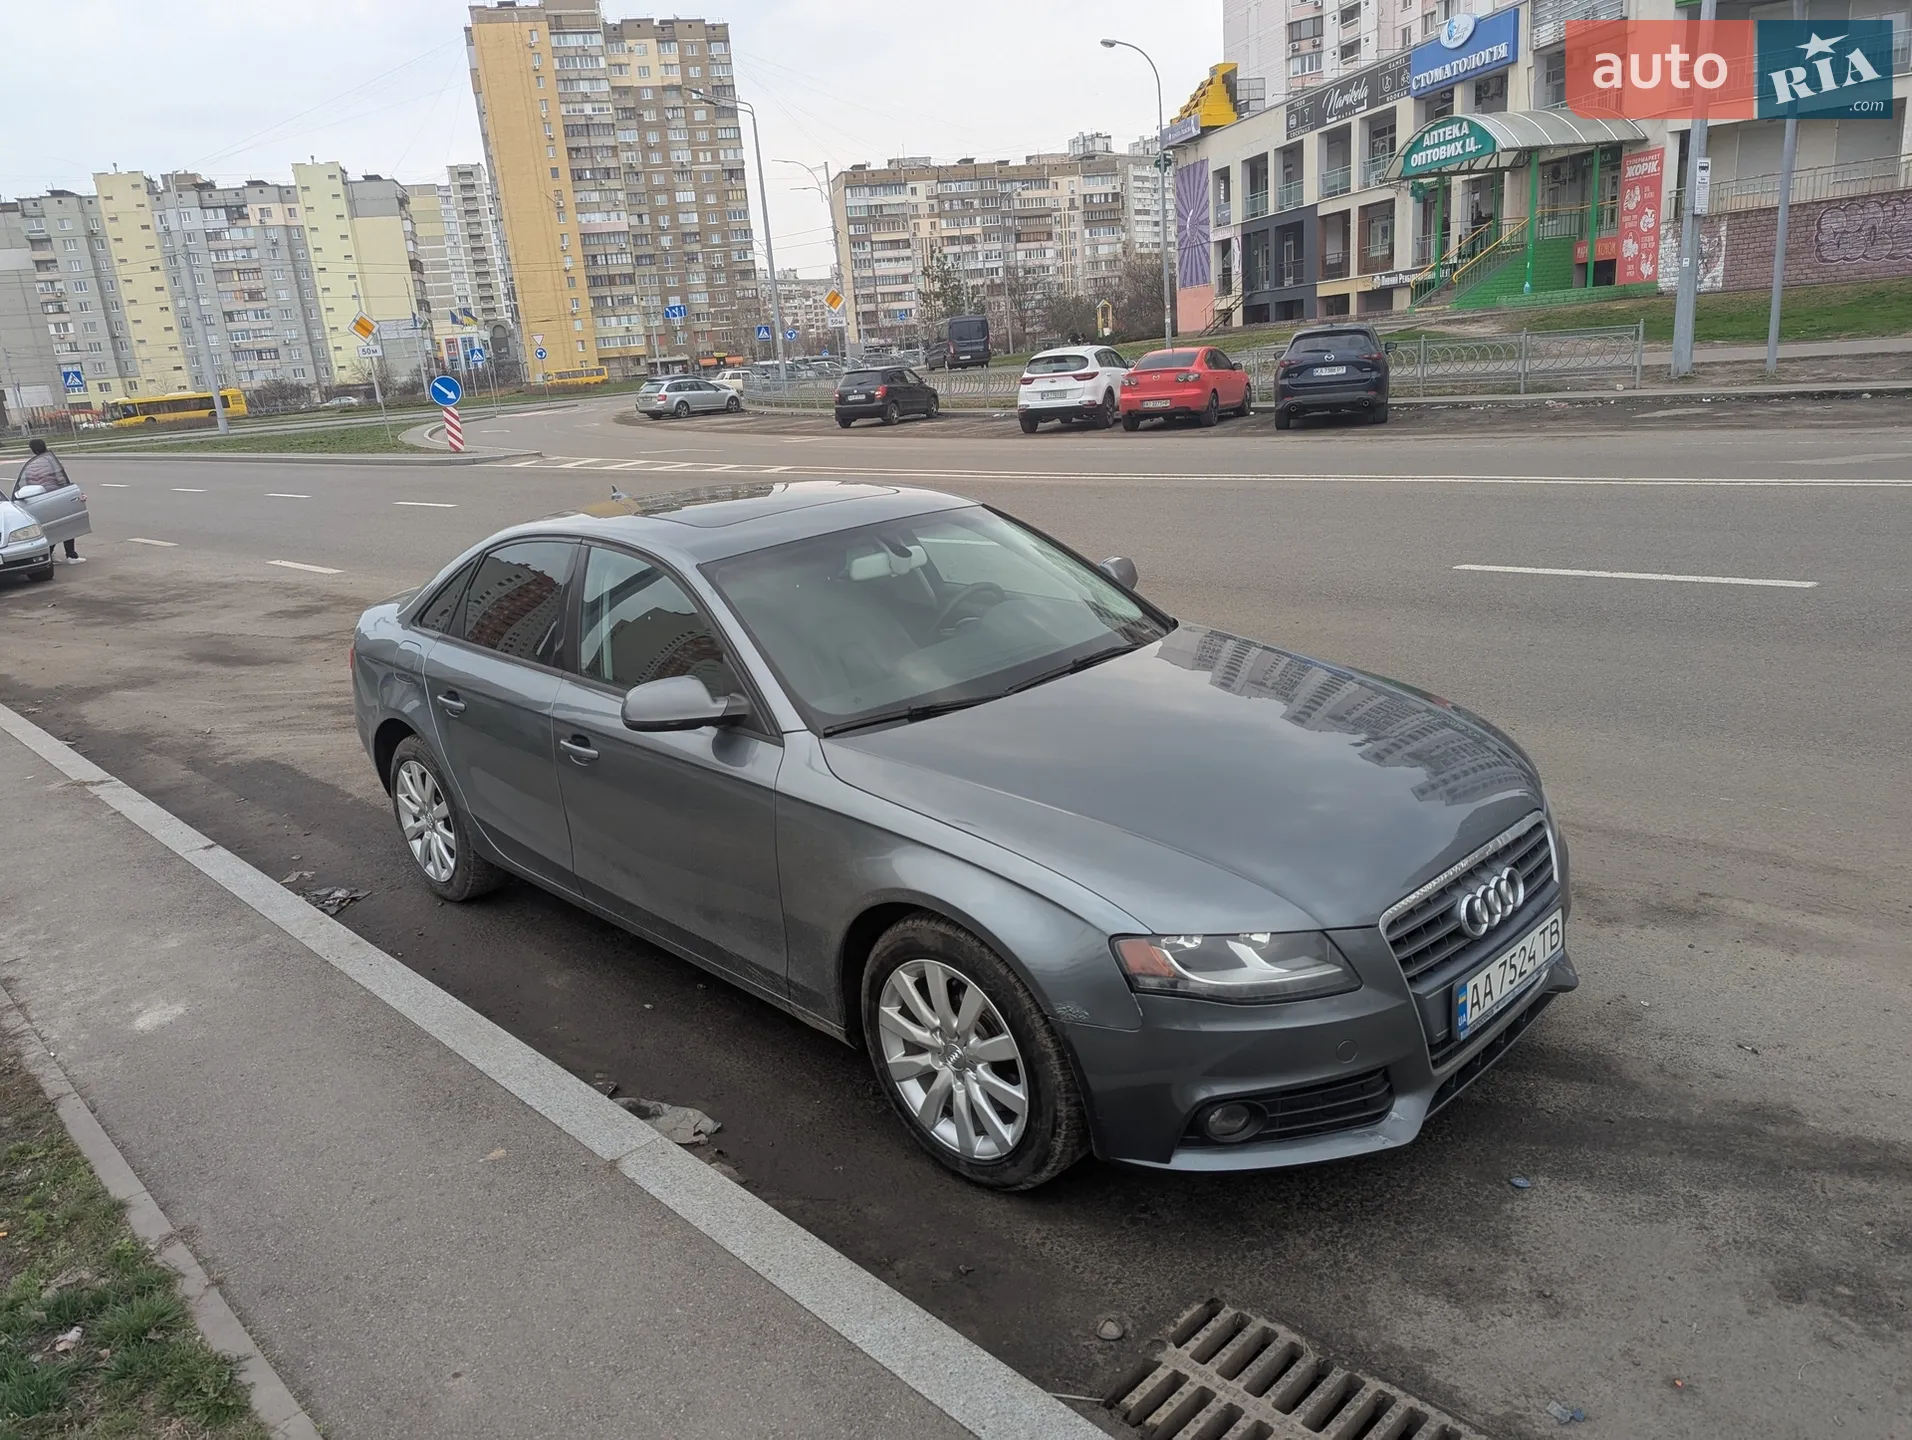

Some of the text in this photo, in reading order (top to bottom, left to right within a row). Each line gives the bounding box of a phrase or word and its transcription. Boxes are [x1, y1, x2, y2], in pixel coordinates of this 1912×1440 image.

[1412, 42, 1509, 90] СТОМАТОЛОГІЯ
[1322, 78, 1369, 116] Narikela
[1423, 121, 1470, 147] АПТЕКА
[1411, 140, 1464, 167] ОПТОВИХ
[1626, 153, 1660, 166] СУПЕРМАРКЕТ
[1625, 161, 1659, 178] ЖОРІК
[1469, 972, 1494, 1020] AA
[1498, 936, 1537, 995] 7524
[1539, 918, 1560, 958] TB
[1458, 1013, 1467, 1026] UA
